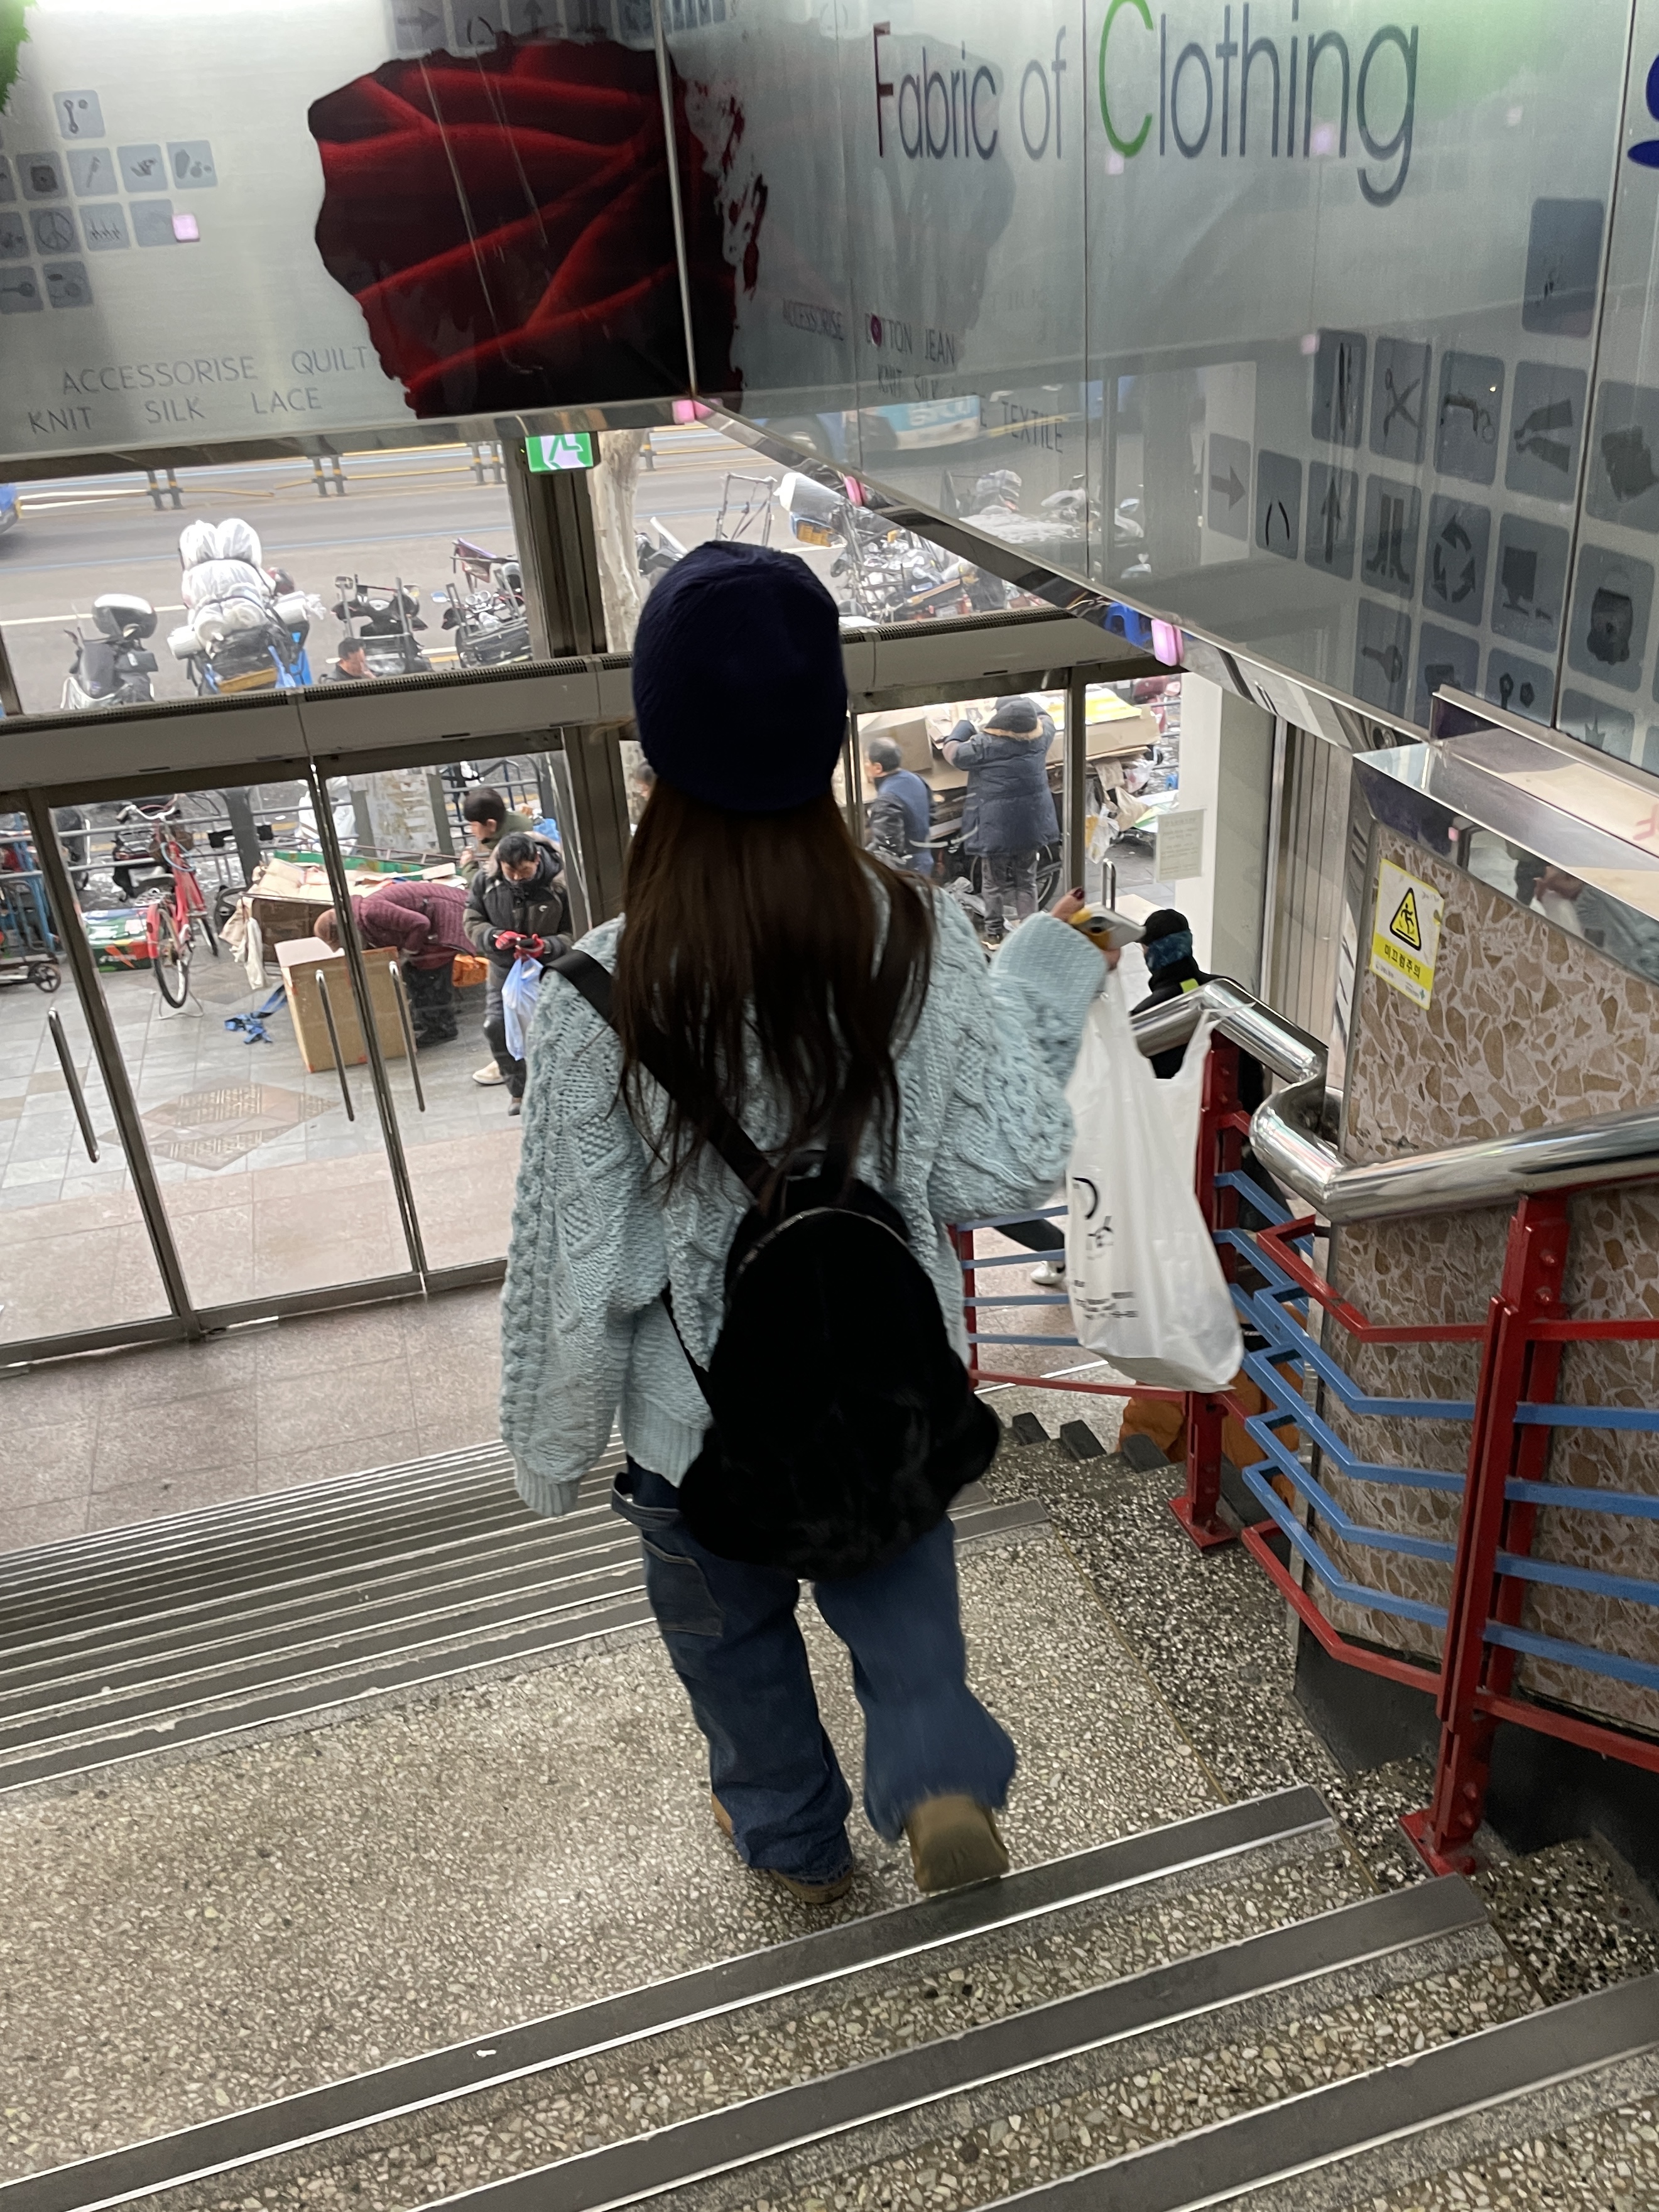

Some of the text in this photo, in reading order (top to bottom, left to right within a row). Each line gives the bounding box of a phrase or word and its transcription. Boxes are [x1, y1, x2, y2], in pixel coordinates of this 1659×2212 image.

[873, 0, 1419, 207] Fabric of Clothing
[62, 345, 369, 396] ACCESSORISE QUILT
[28, 386, 323, 435] KNIT SILK LACE
[1002, 400, 1063, 454] TEXTILE
[1384, 943, 1421, 980] 미끄럼주의
